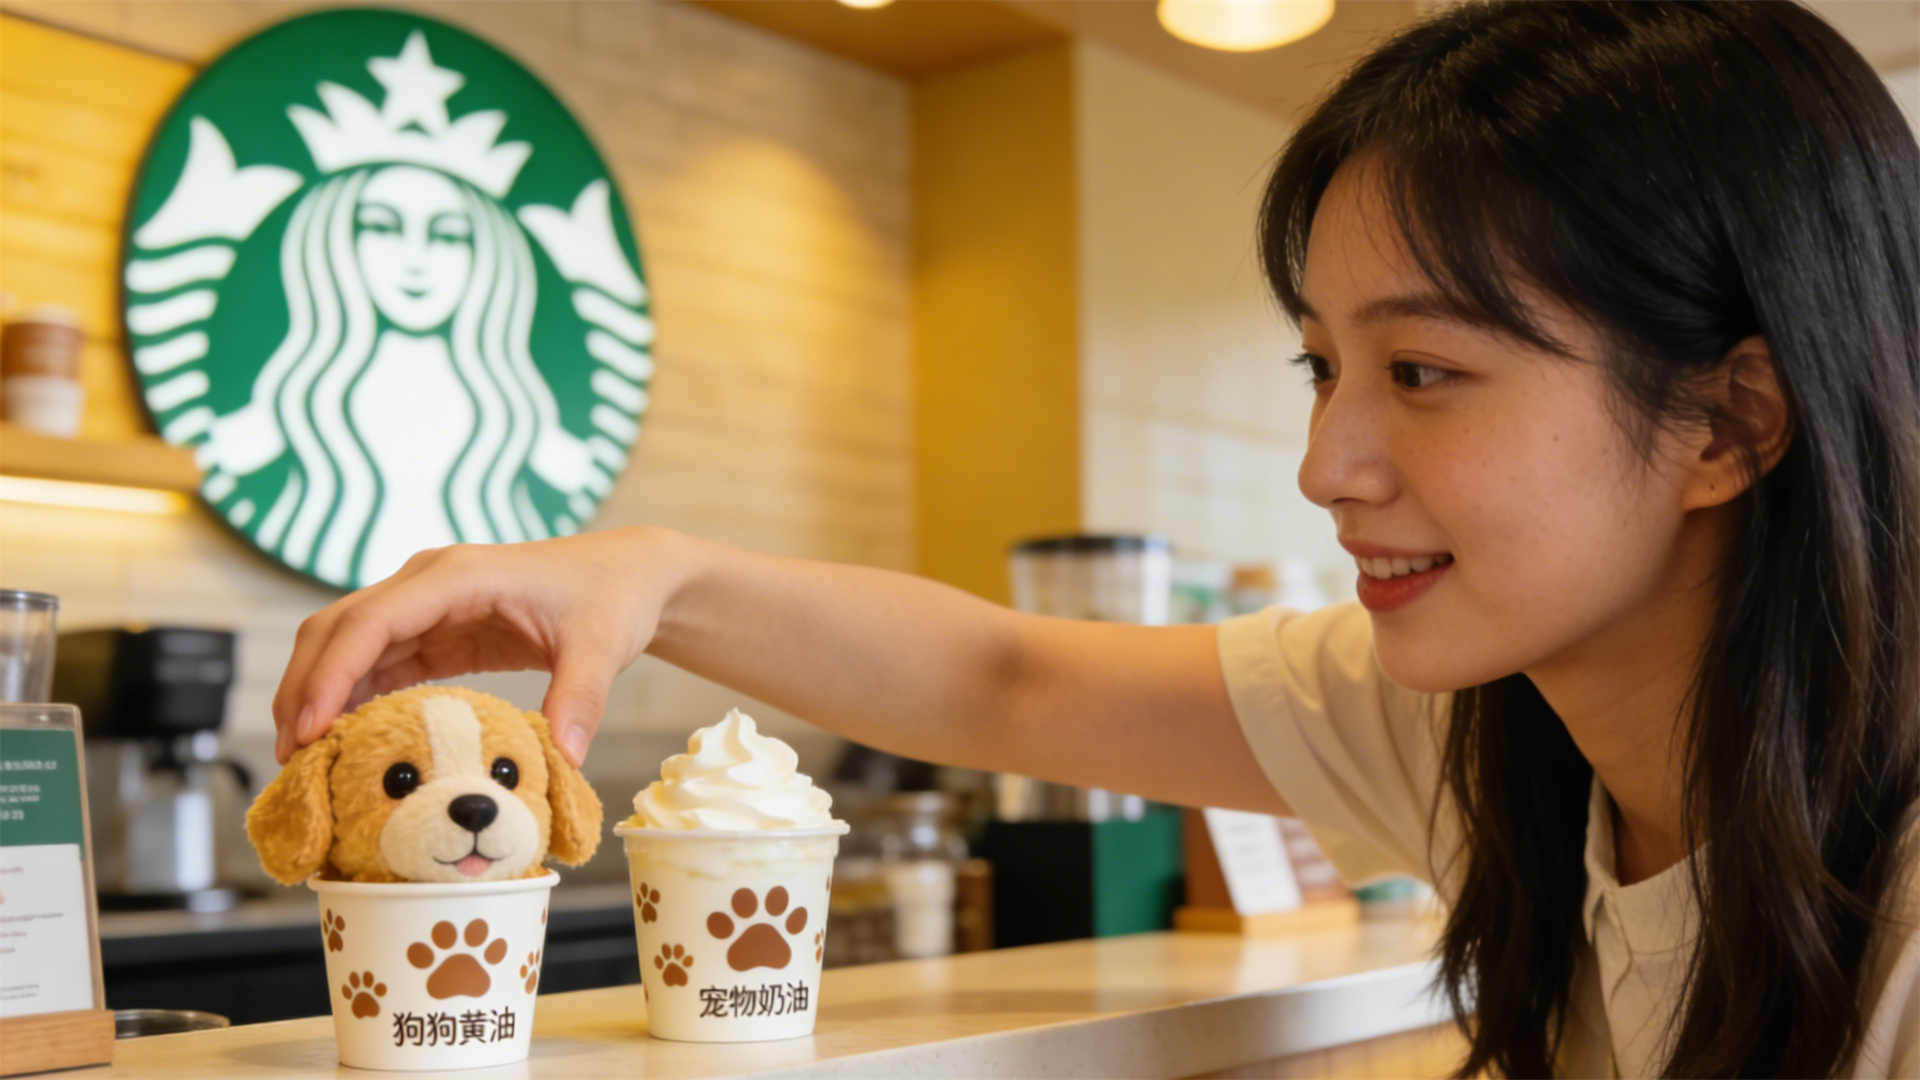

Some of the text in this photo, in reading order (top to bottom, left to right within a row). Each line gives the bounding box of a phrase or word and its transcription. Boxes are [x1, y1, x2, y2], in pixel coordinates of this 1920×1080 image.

[699, 980, 809, 1018] 宠物奶油
[392, 1005, 516, 1047] 狗狗黄油
